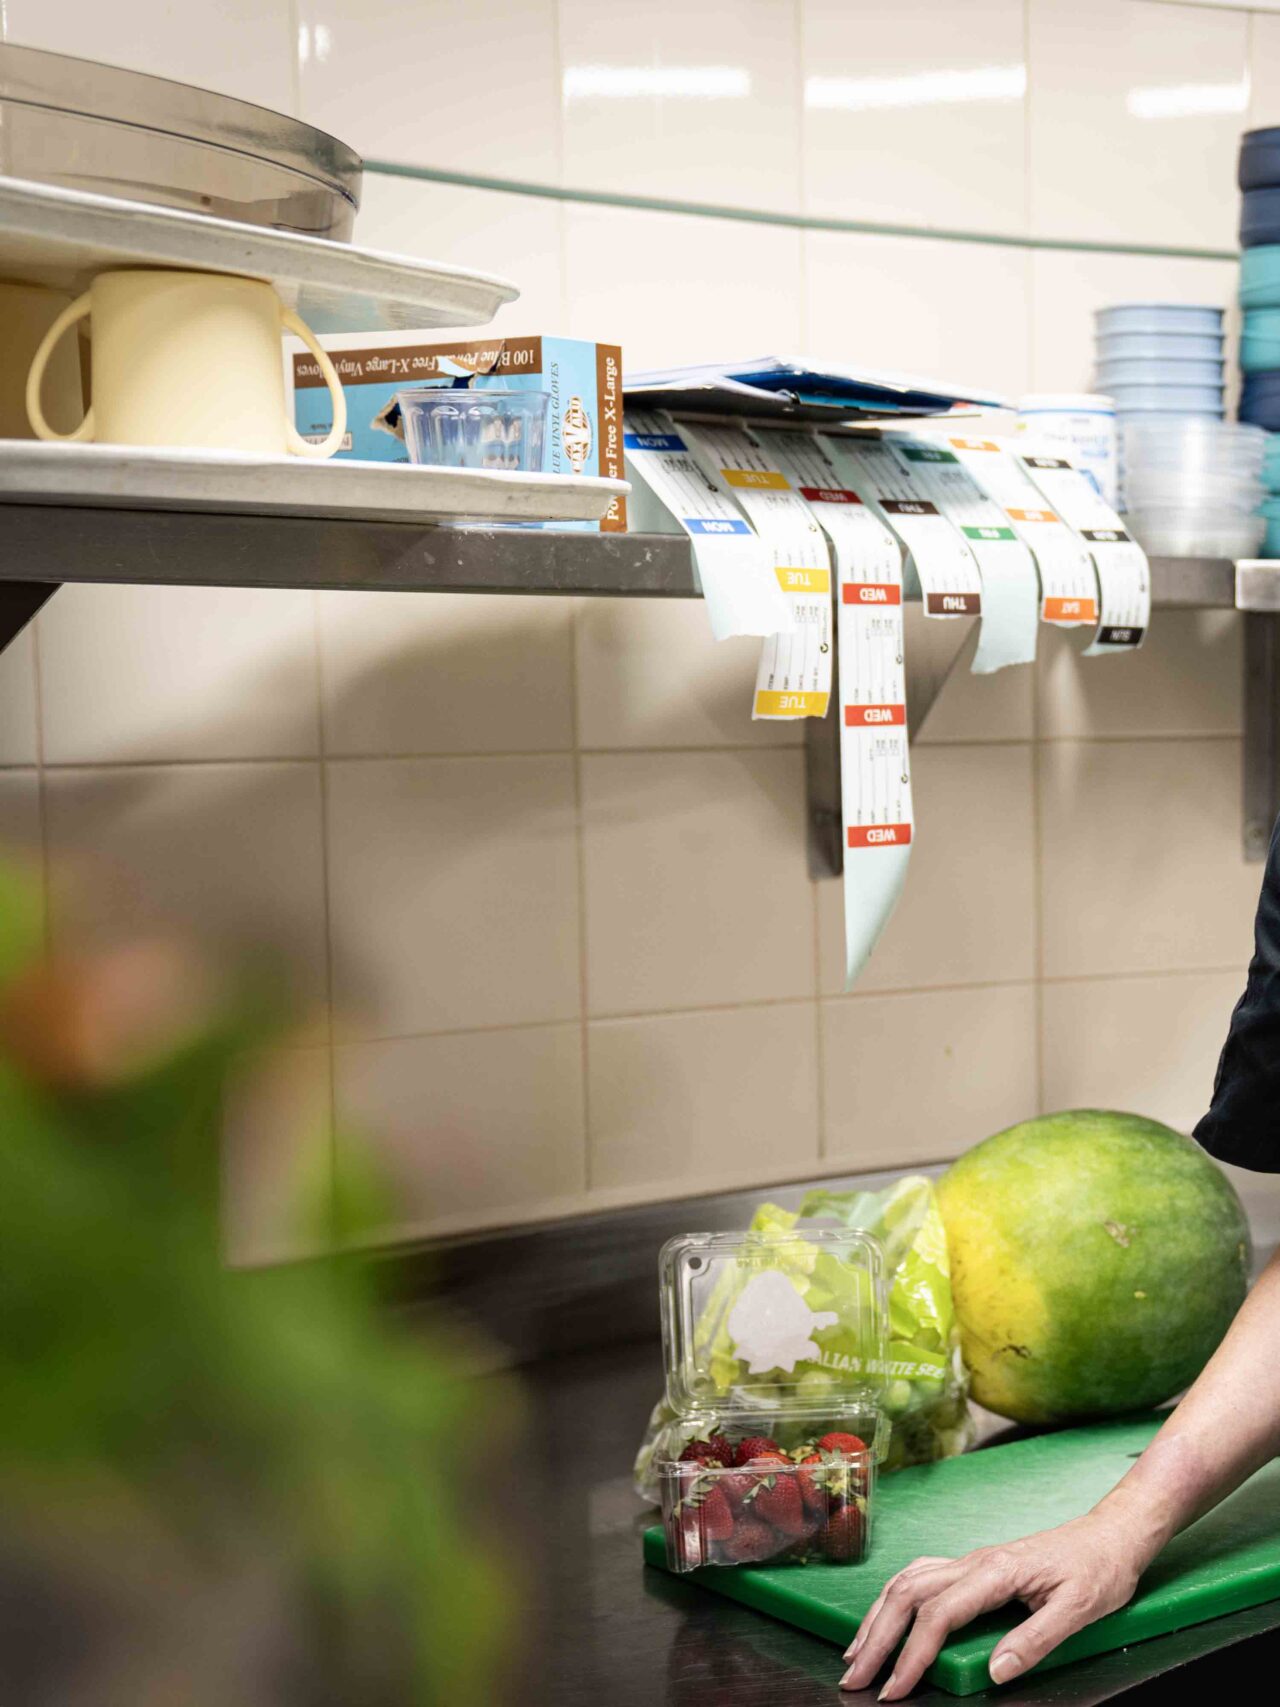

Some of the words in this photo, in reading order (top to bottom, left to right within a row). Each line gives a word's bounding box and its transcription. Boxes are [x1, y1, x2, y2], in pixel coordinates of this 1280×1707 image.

[412, 355, 436, 371] Free
[513, 349, 535, 365] 100
[296, 364, 324, 379] loves
[366, 357, 410, 374] X-Large
[550, 361, 560, 410] GLOVES
[604, 357, 618, 420] X-Large
[551, 412, 561, 448] VINYL
[605, 426, 617, 459] Free
[637, 437, 669, 448] MON
[552, 452, 561, 474] LUE
[742, 473, 770, 484] TUE
[606, 463, 619, 521] Poer
[819, 491, 848, 500] WED
[702, 520, 735, 533] MON
[787, 572, 811, 585] TUE
[859, 588, 887, 600] WED
[943, 596, 967, 610] THU
[779, 695, 806, 709] TUE
[864, 708, 893, 722] WED
[866, 829, 897, 842] WED
